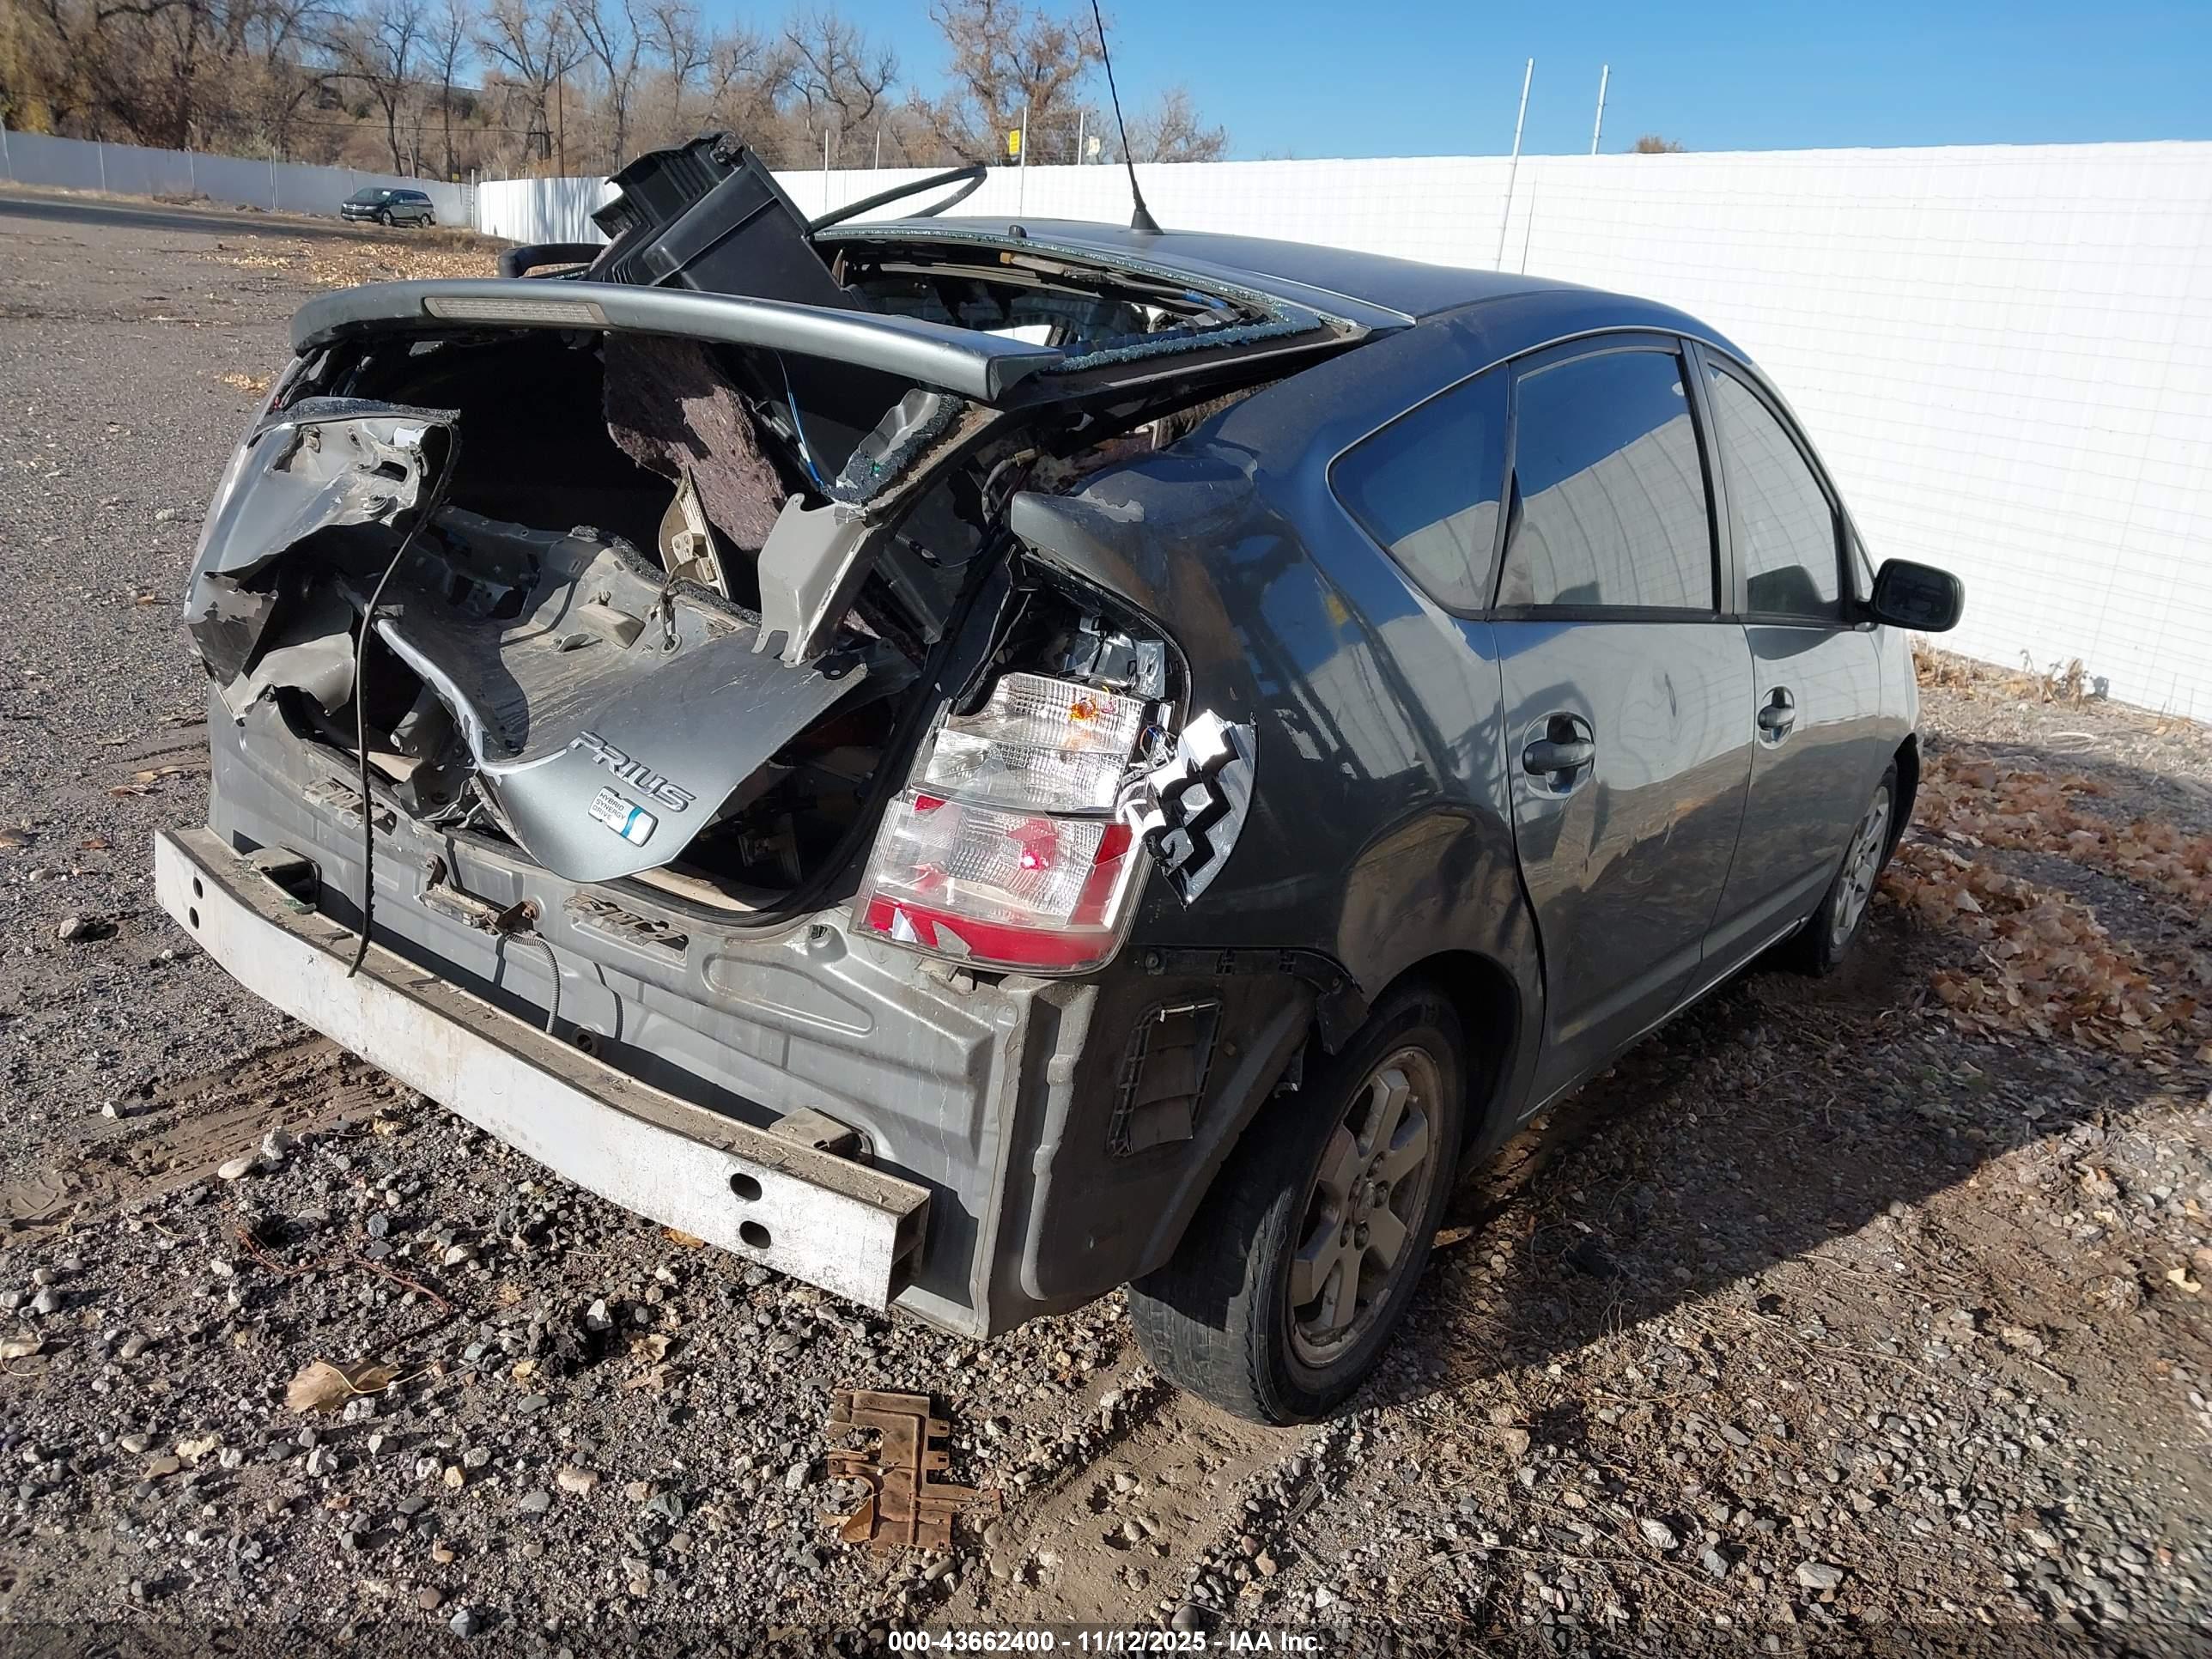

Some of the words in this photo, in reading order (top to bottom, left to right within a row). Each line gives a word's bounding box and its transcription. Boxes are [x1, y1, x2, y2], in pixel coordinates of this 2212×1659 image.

[569, 730, 697, 813] PRIUS
[595, 799, 626, 819] SYNERGY
[599, 792, 625, 811] HYBRID
[592, 805, 612, 820] DRIVE
